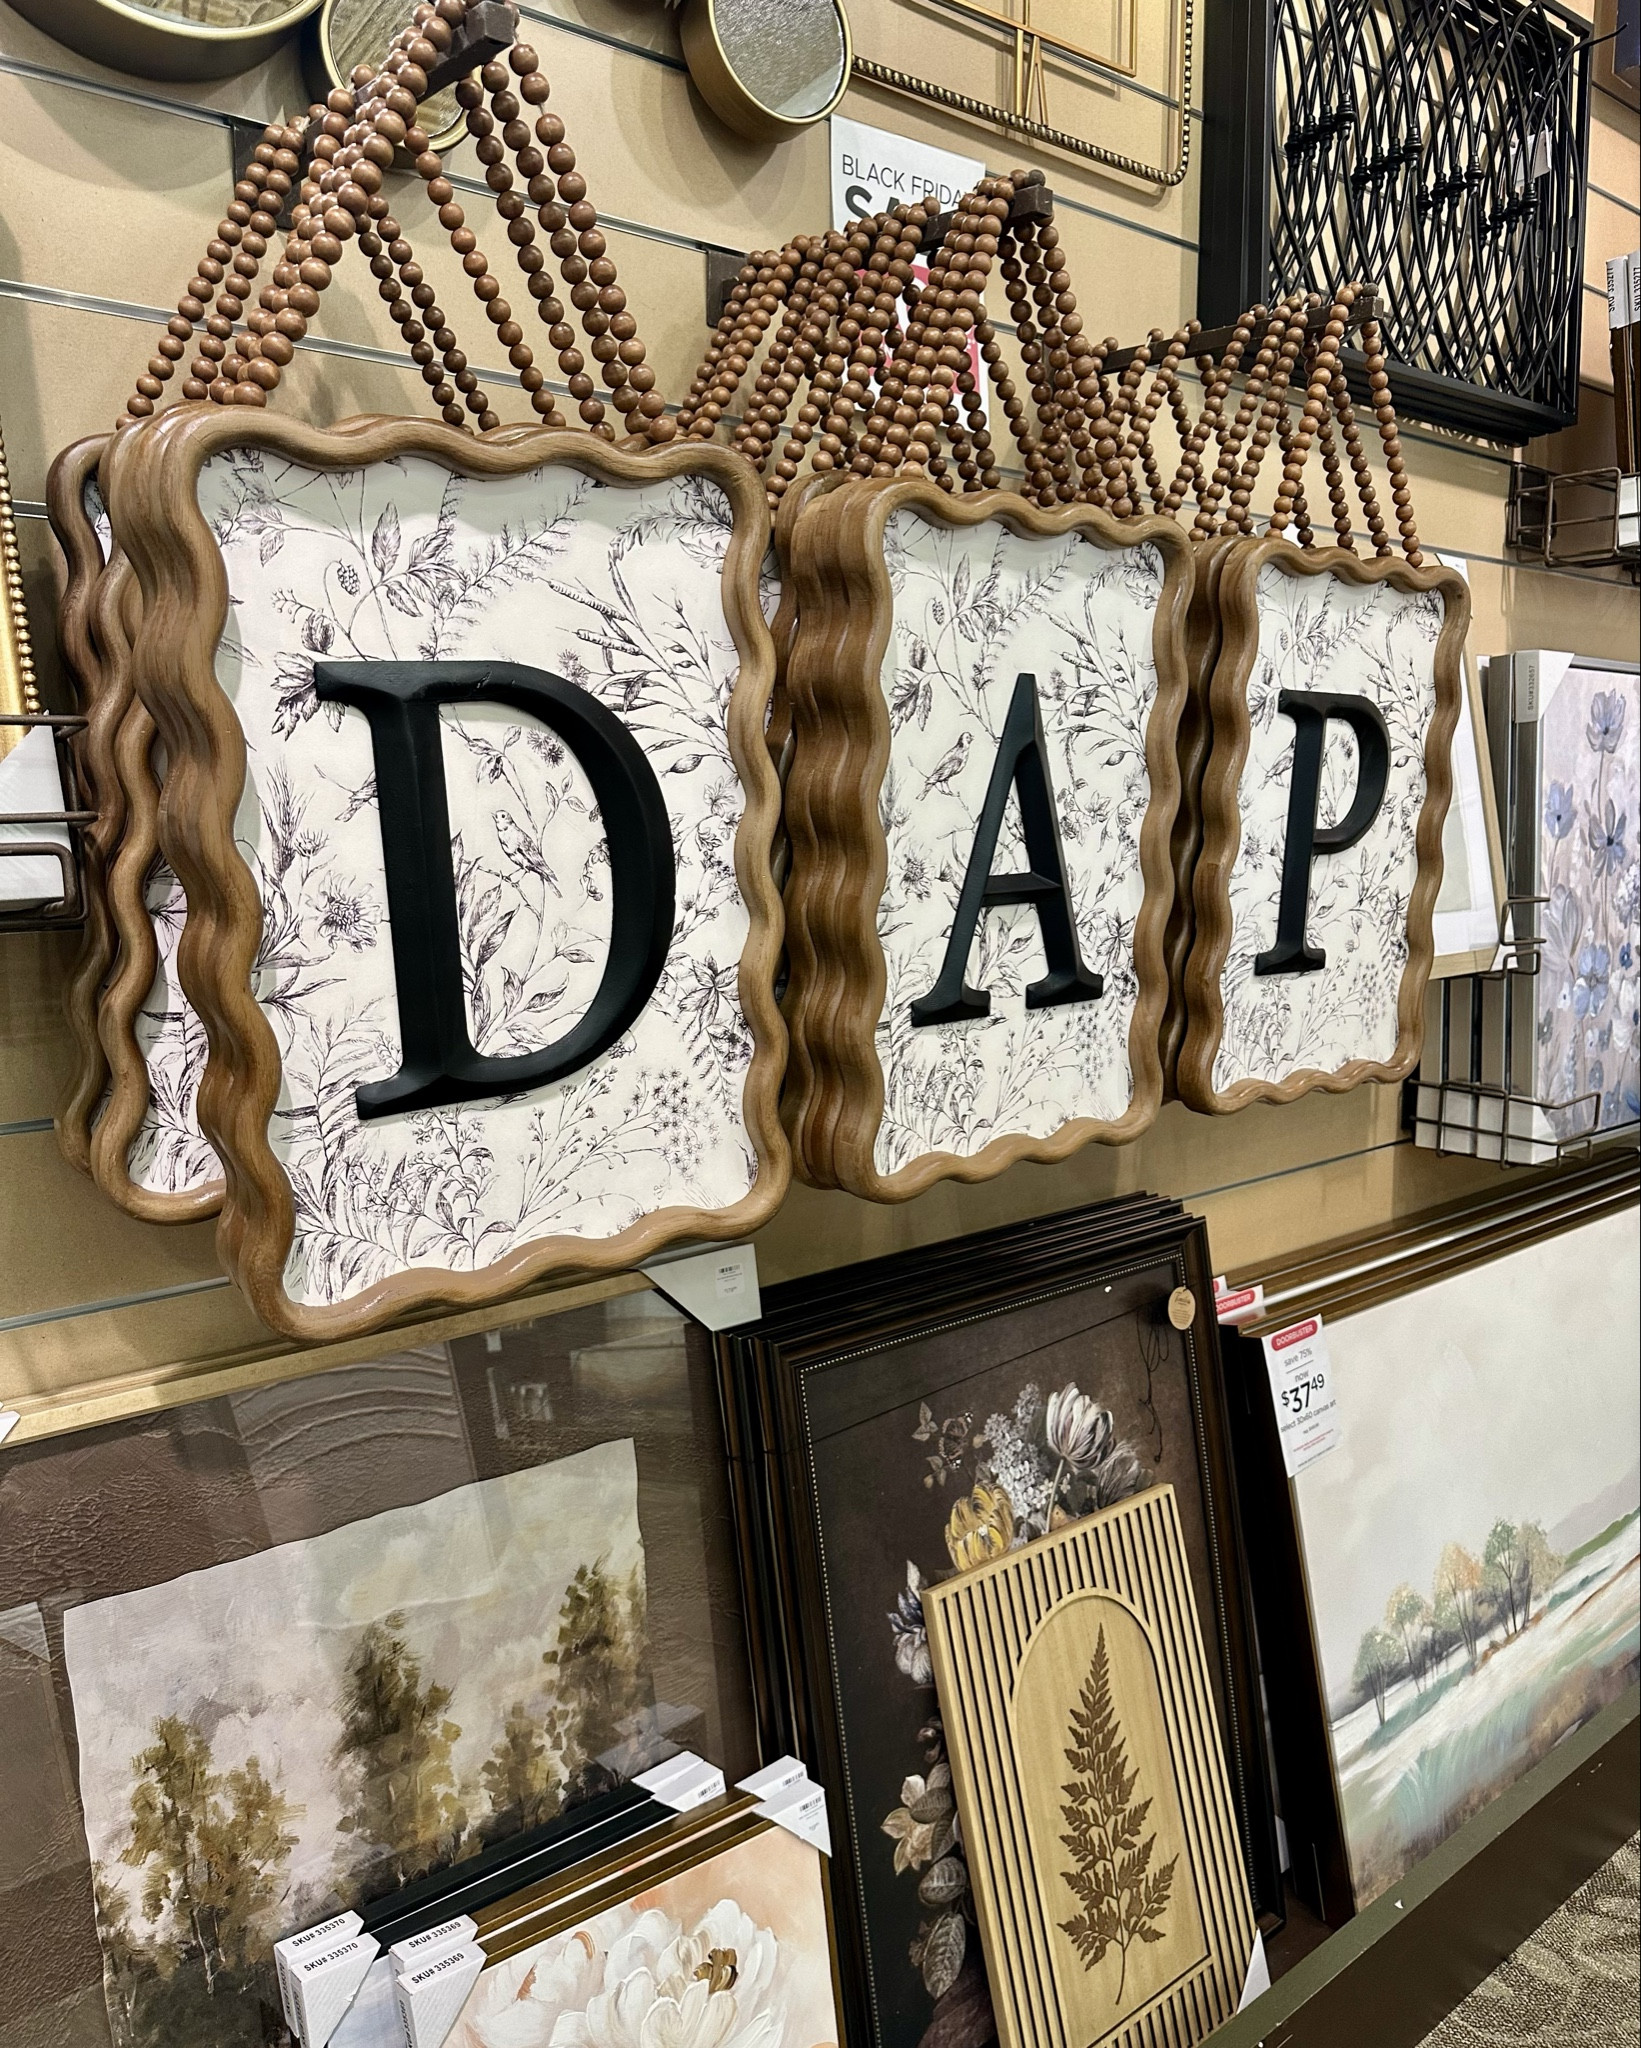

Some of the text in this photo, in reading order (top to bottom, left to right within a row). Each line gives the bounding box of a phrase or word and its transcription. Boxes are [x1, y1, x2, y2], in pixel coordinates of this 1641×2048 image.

[842, 154, 963, 207] BLACK FRIDA
[1253, 689, 1391, 976] P
[911, 672, 1104, 1027] A
[313, 659, 675, 1121] D
[1275, 1324, 1314, 1346] DOORBUSTER
[1284, 1347, 1312, 1367] save 75%
[1294, 1370, 1309, 1382] now
[292, 1918, 346, 1947] SKU# 335370
[408, 1921, 462, 1948] SKU# 335369
[304, 1942, 359, 1972] SKU# 335370
[411, 1967, 435, 1984] SKU#
[434, 1952, 465, 1971] 335369
